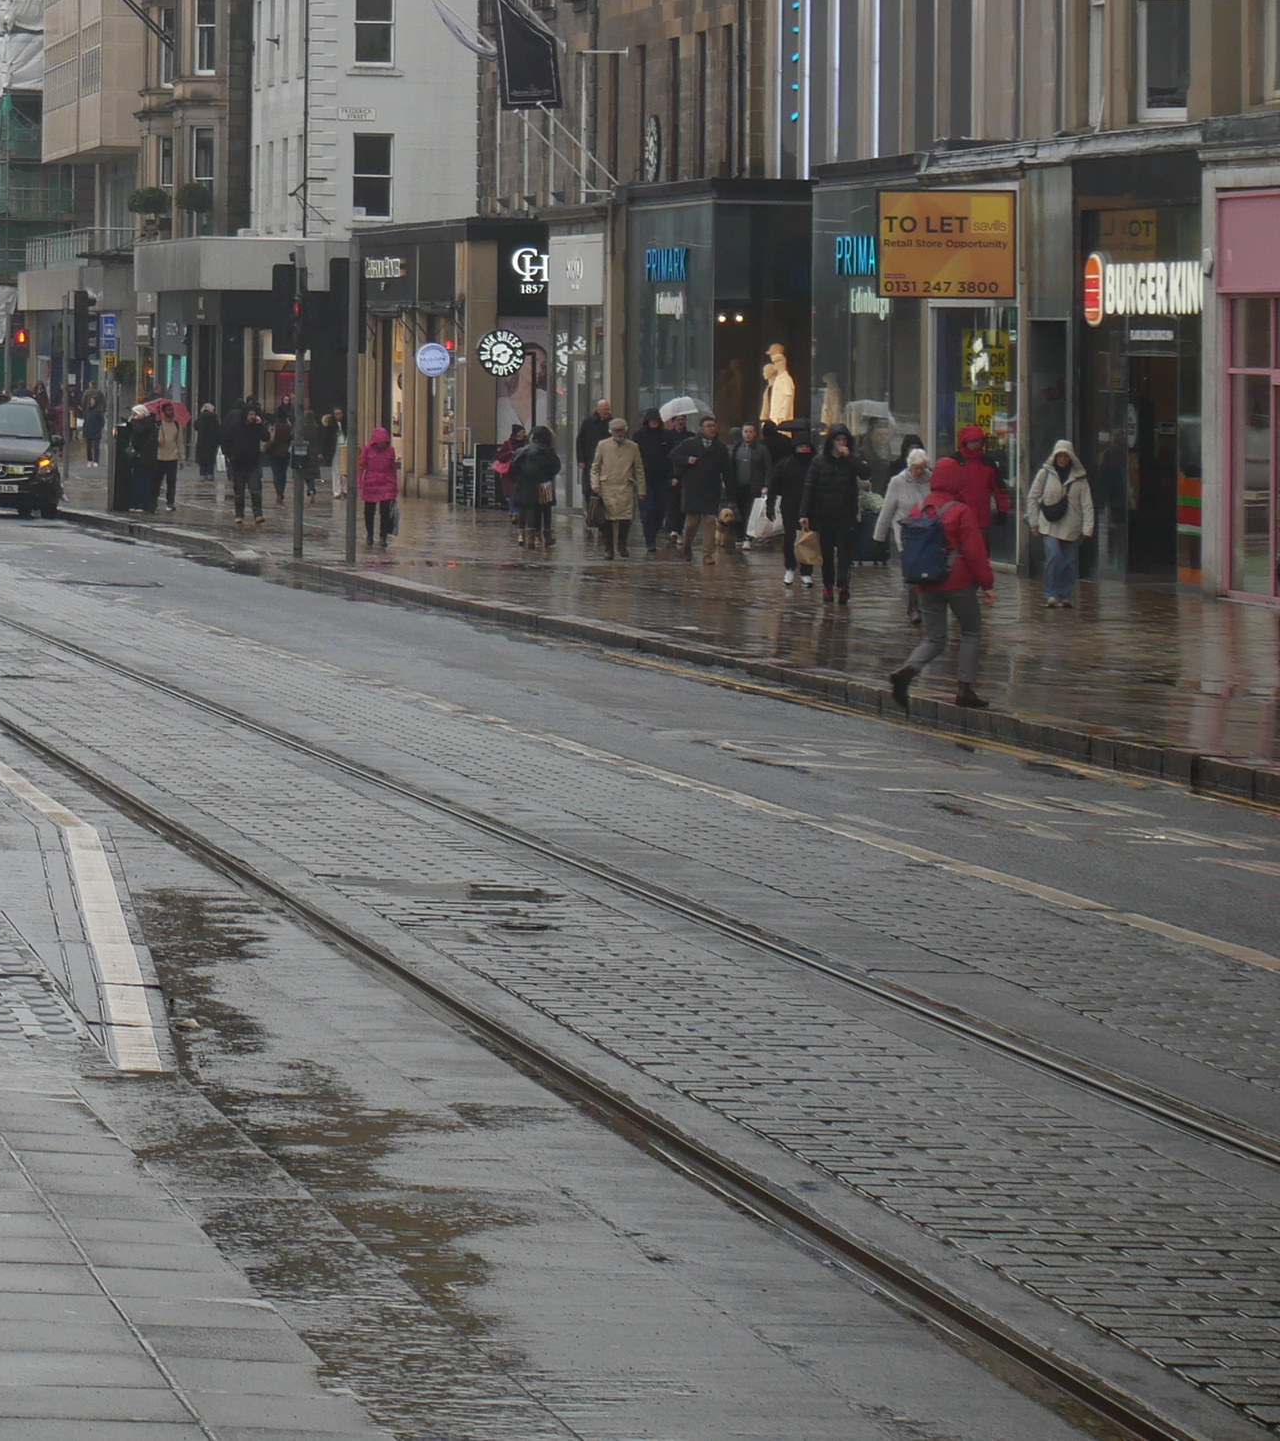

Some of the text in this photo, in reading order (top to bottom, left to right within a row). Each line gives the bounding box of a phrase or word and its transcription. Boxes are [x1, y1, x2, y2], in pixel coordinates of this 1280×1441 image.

[884, 216, 968, 233] TO LET
[973, 220, 1007, 231] savills
[884, 239, 1008, 249] Retail Store Opportunity
[646, 247, 687, 282] PRIMARK
[835, 235, 876, 276] PRIMA
[520, 284, 545, 294] 1857
[884, 281, 999, 293] 0131 247 3800
[1105, 261, 1168, 315] BURGER
[480, 330, 523, 361] BLACK SHEEP
[492, 356, 524, 376] COFFEE
